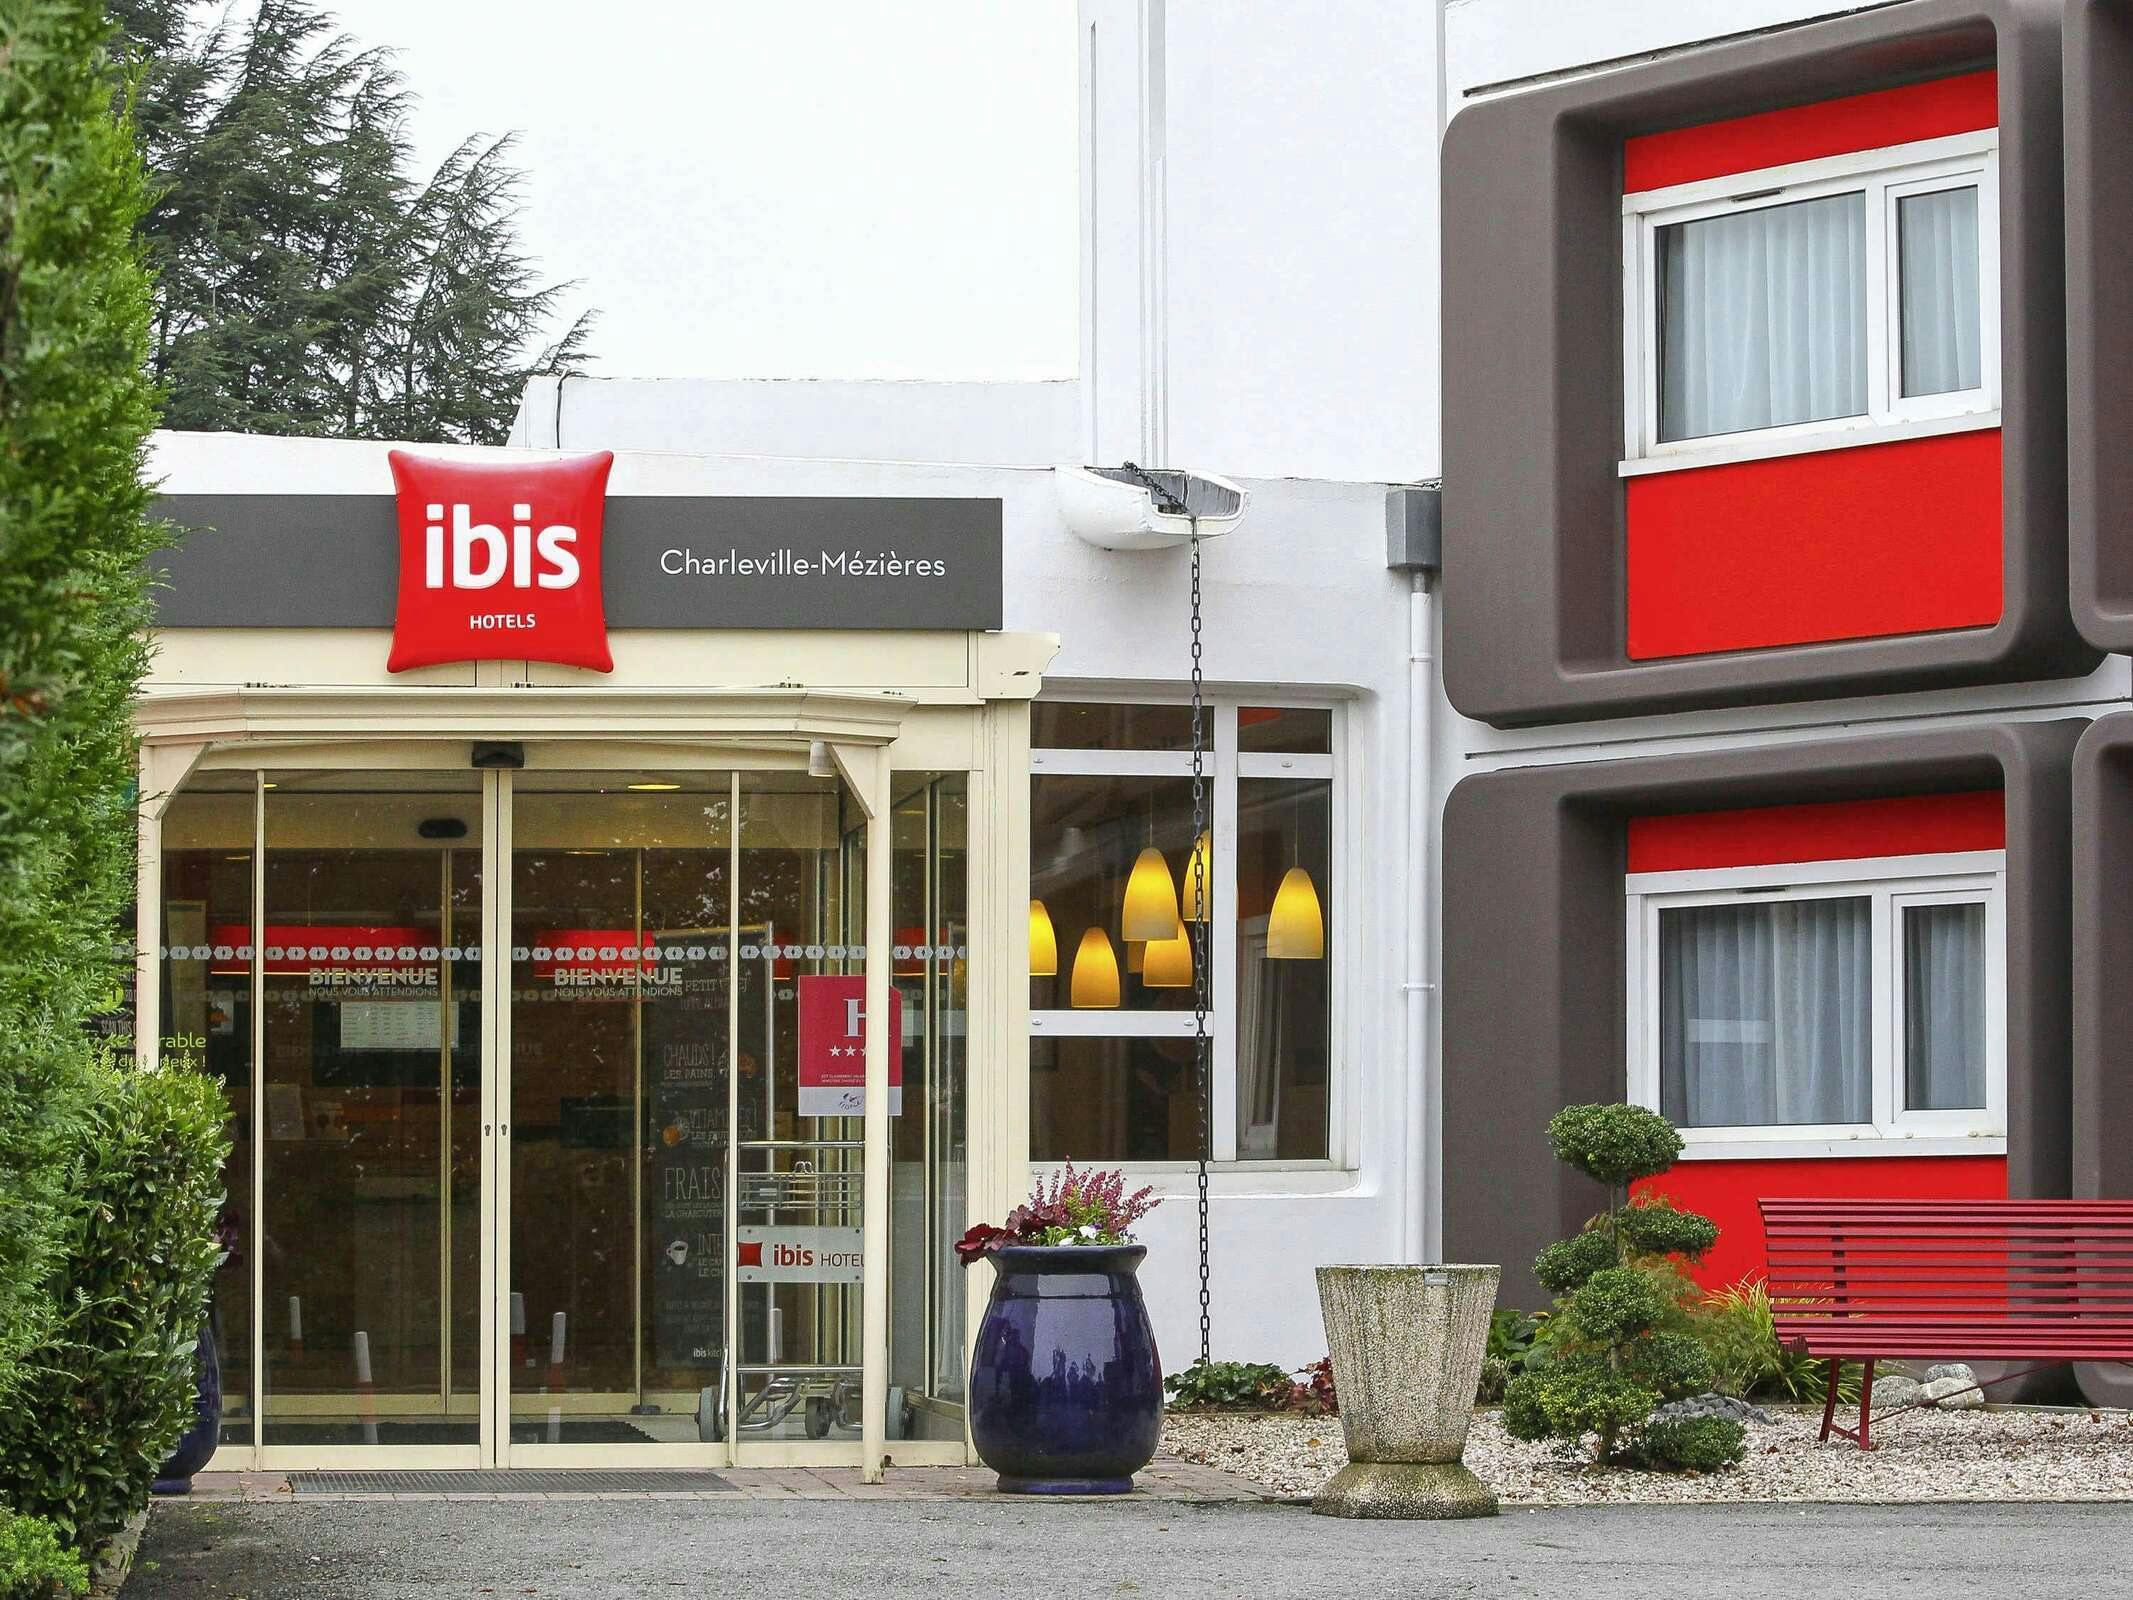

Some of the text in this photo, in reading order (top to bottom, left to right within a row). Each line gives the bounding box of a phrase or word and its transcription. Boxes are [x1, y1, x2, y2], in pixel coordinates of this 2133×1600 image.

[426, 503, 580, 590] ibis
[660, 548, 946, 577] Charleville-Mézières
[469, 613, 536, 630] HOTELS
[309, 967, 438, 985] BIENVENUE
[554, 967, 683, 986] BIENVENUE
[309, 986, 438, 997] NOUS VOUS ATTENDIONS
[555, 985, 683, 998] NOUS VOUS ATTENDIONS
[159, 1032, 206, 1048] rable
[665, 1167, 721, 1200] FRAIS
[697, 1233, 722, 1256] INTE
[773, 1244, 814, 1266] ibis
[693, 1348, 706, 1358] ibis
